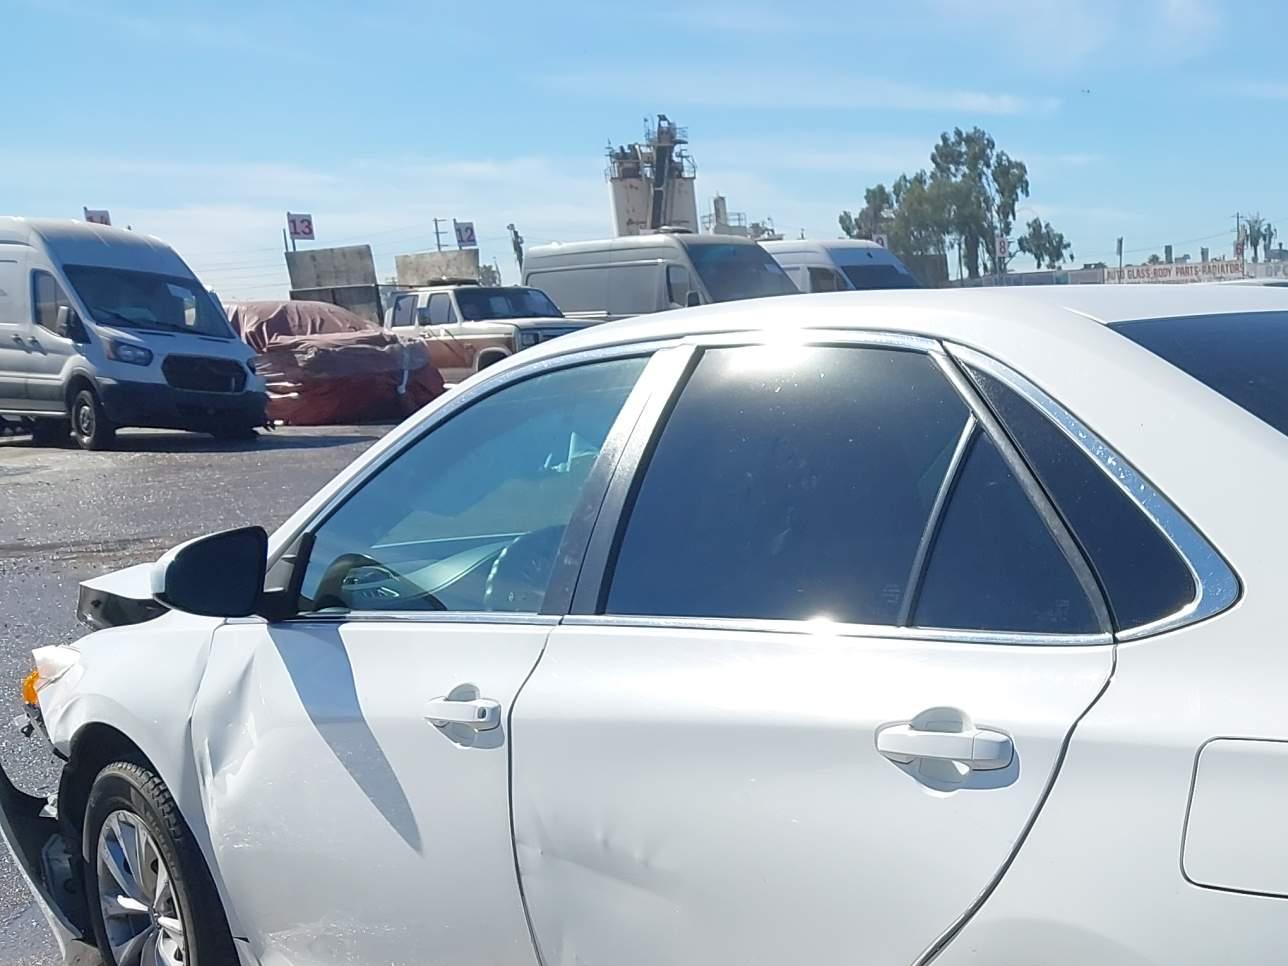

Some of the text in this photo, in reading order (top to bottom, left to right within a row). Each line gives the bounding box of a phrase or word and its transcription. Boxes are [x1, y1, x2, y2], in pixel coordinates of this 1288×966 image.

[289, 219, 313, 235] 13
[455, 226, 476, 244] 12
[999, 240, 1006, 255] 8
